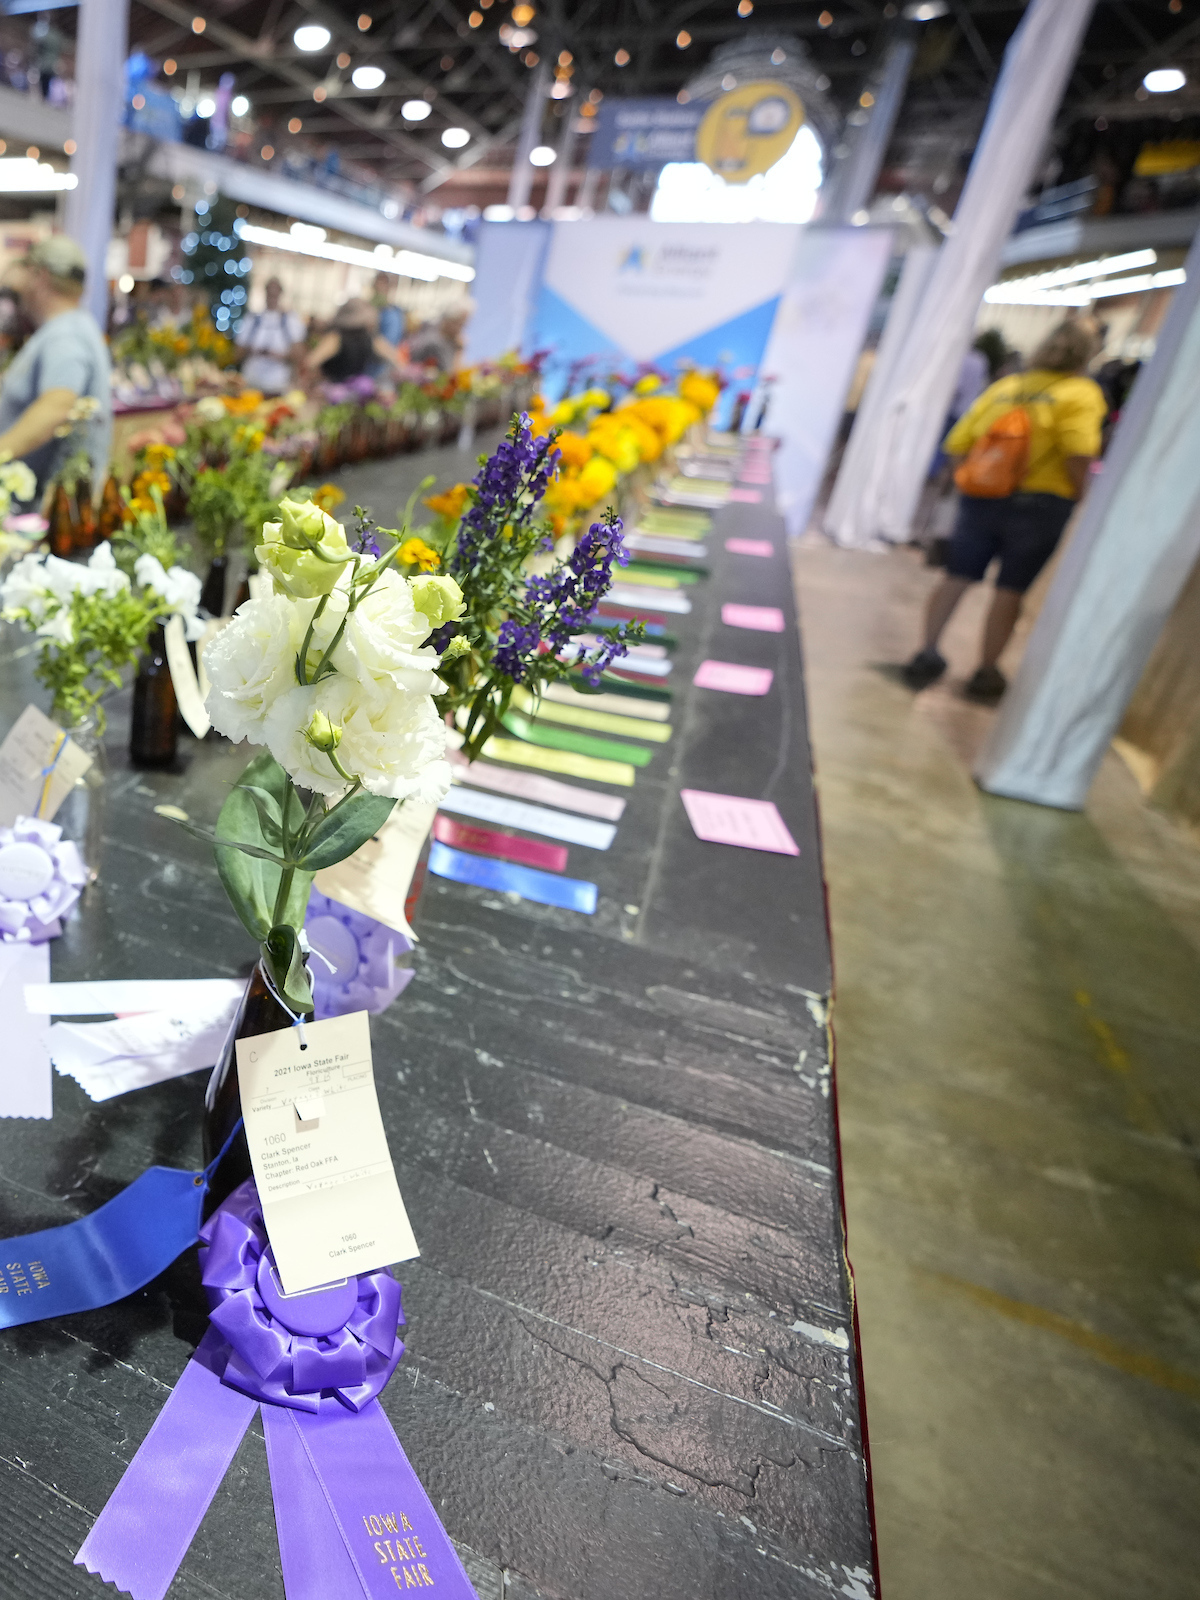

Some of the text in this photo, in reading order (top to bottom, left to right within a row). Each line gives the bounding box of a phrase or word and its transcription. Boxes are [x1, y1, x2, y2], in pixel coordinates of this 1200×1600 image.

[274, 1054, 349, 1077] 2021 Iowa State Fair
[306, 1064, 341, 1076] Floriculture
[252, 1104, 272, 1113] Variety
[259, 1096, 277, 1104] Division
[264, 1132, 287, 1147] 1060
[261, 1142, 311, 1161] Clark Spencer
[263, 1159, 290, 1171] Stanton,
[265, 1155, 339, 1181] Chapter: Red Oak FFA
[268, 1179, 301, 1192] Description
[341, 1232, 357, 1243] 1060
[328, 1240, 376, 1258] Clark Spencer
[6, 1262, 33, 1297] STATE
[28, 1260, 51, 1290] IOWA
[362, 1511, 414, 1537] IOWA
[373, 1535, 428, 1564] STATE
[390, 1563, 435, 1590] FAIR
